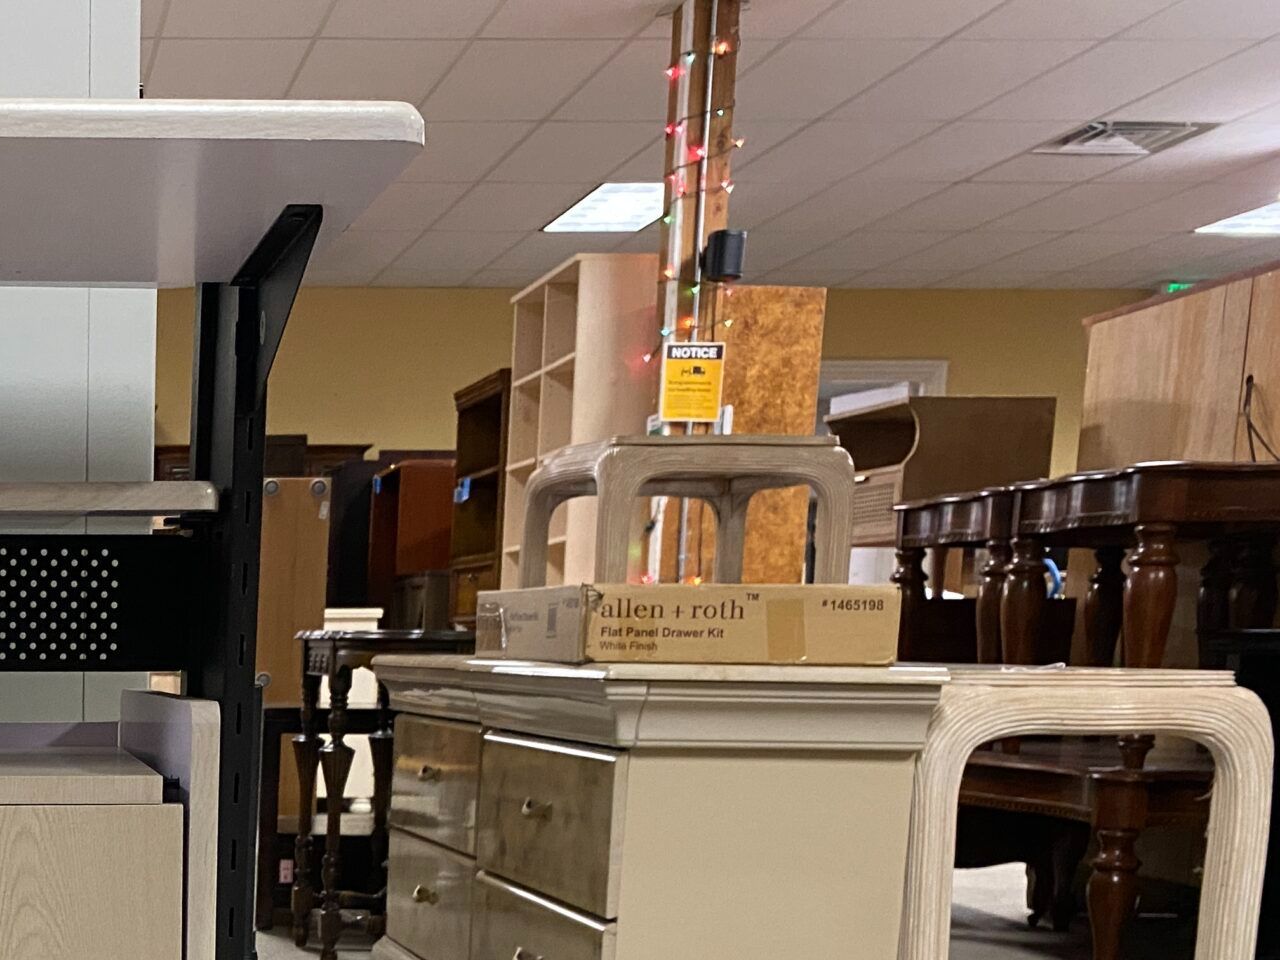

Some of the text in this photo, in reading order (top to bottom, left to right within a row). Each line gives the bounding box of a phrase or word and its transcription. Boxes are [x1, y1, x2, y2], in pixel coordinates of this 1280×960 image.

[671, 347, 718, 358] NOTICE
[600, 598, 664, 619] allen
[691, 599, 744, 620] roth
[822, 599, 884, 611] #1465198
[600, 626, 724, 639] Flat Panel Drawer Kit
[600, 641, 658, 651] White Finish
